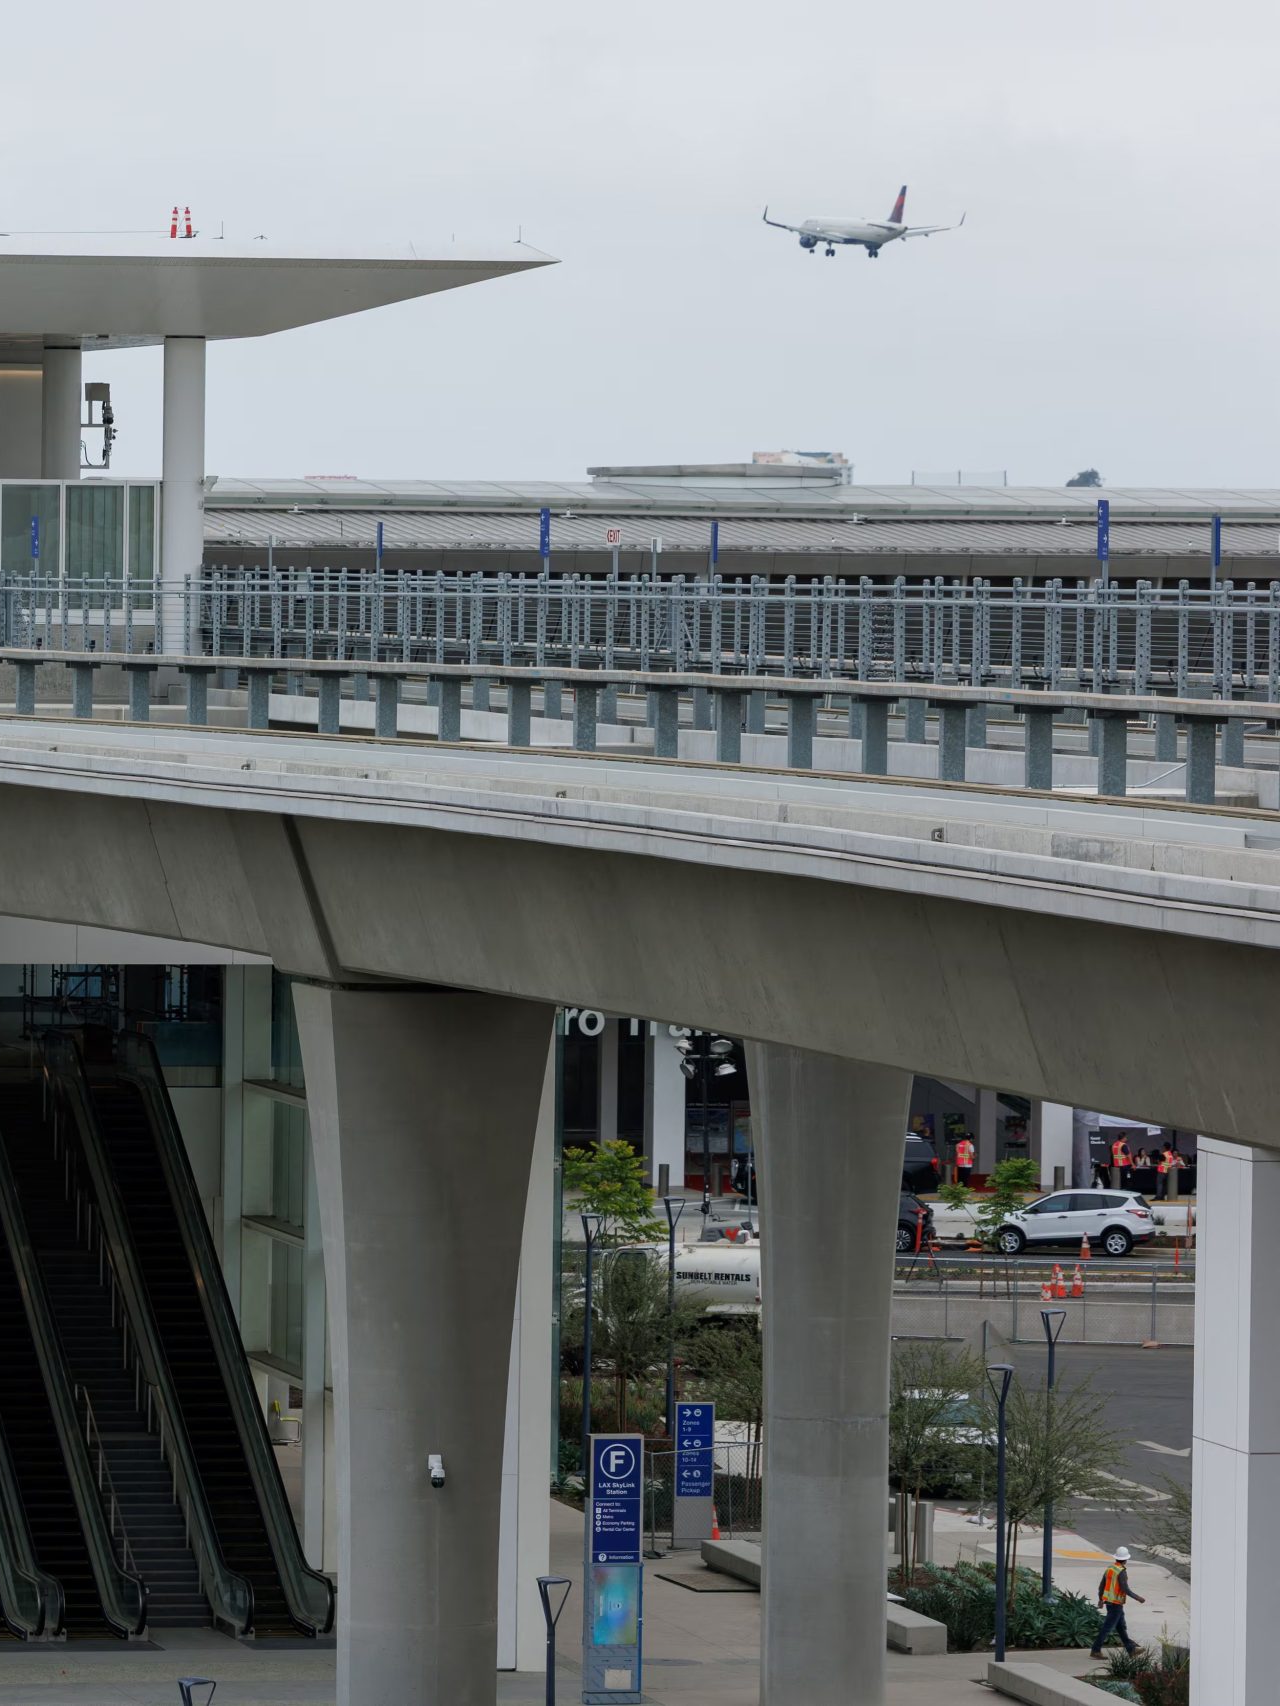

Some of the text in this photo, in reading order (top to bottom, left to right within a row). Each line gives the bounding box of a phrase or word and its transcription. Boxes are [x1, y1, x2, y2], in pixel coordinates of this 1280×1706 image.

[608, 529, 621, 543] EXIT
[676, 1272, 751, 1282] SUNBELT RENTALS
[609, 1450, 626, 1473] F
